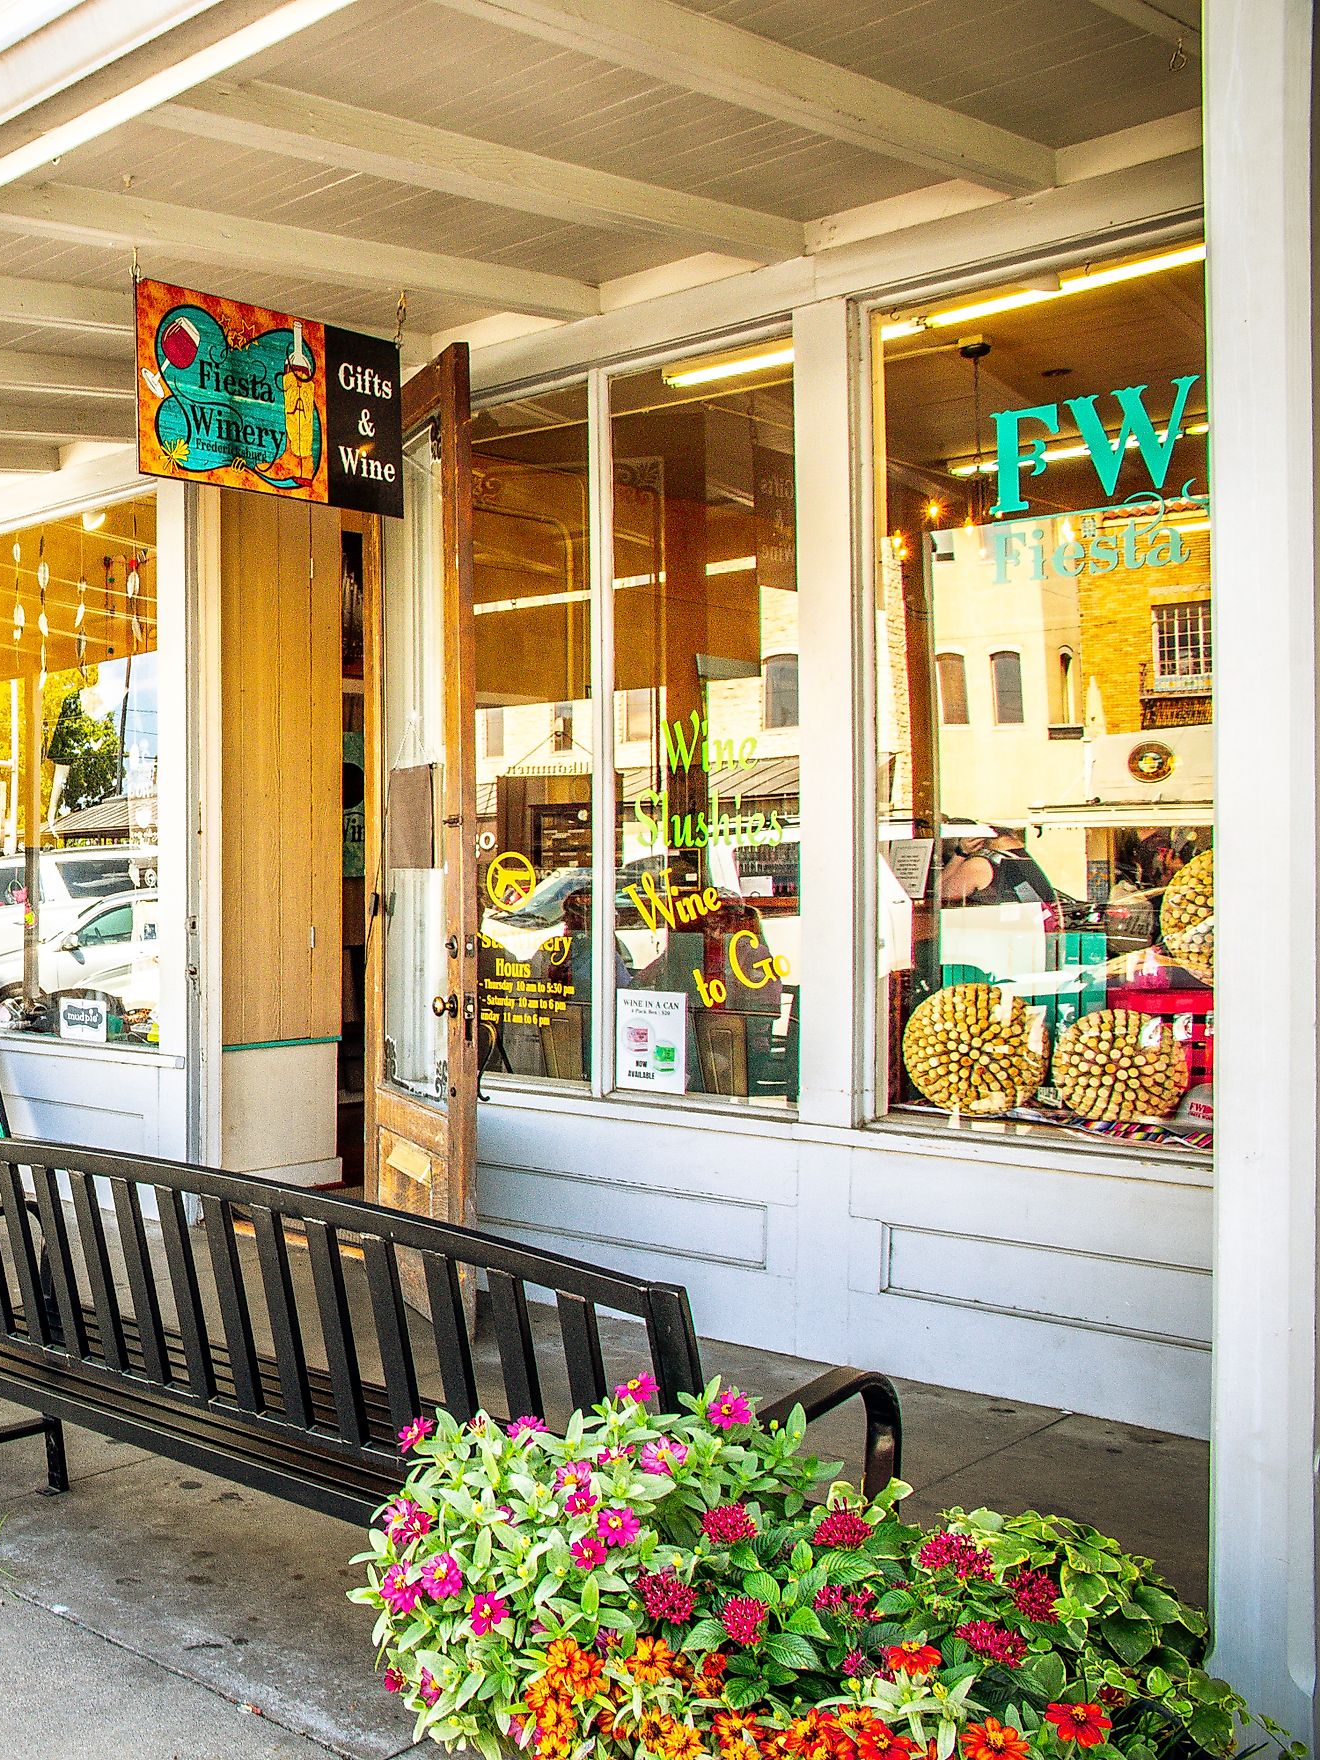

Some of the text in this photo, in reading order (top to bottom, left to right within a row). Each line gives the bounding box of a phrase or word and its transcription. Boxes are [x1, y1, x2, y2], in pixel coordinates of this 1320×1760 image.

[199, 358, 276, 404] Fiesta
[337, 362, 393, 400] Gifts
[190, 403, 286, 455] Winery
[358, 409, 375, 438] &
[338, 445, 396, 483] Wine
[989, 375, 1201, 516] FW
[992, 492, 1191, 586] Fiesta
[662, 709, 759, 775] Wine
[634, 788, 784, 848] Slushies
[622, 867, 722, 935] Wine
[495, 957, 531, 978] Hours
[693, 929, 792, 1008] to Go
[484, 979, 514, 993] Thursday
[516, 981, 525, 992] 10
[537, 982, 546, 993] to
[546, 982, 562, 994] 5:30
[563, 985, 575, 997] pm
[487, 995, 515, 1009] Saturday
[518, 997, 527, 1007] 10
[540, 998, 548, 1009] to
[548, 998, 555, 1010] 6
[555, 1001, 567, 1012] pm
[623, 999, 643, 1008] WINE
[655, 1001, 661, 1009] A
[663, 1001, 680, 1010] CAN
[480, 1011, 500, 1024] unday
[503, 1012, 511, 1023] 11
[524, 1013, 532, 1024] to
[532, 1013, 538, 1025] 6
[539, 1016, 551, 1027] pm
[628, 1070, 655, 1080] AVAILABLE
[635, 1060, 648, 1068] NOW
